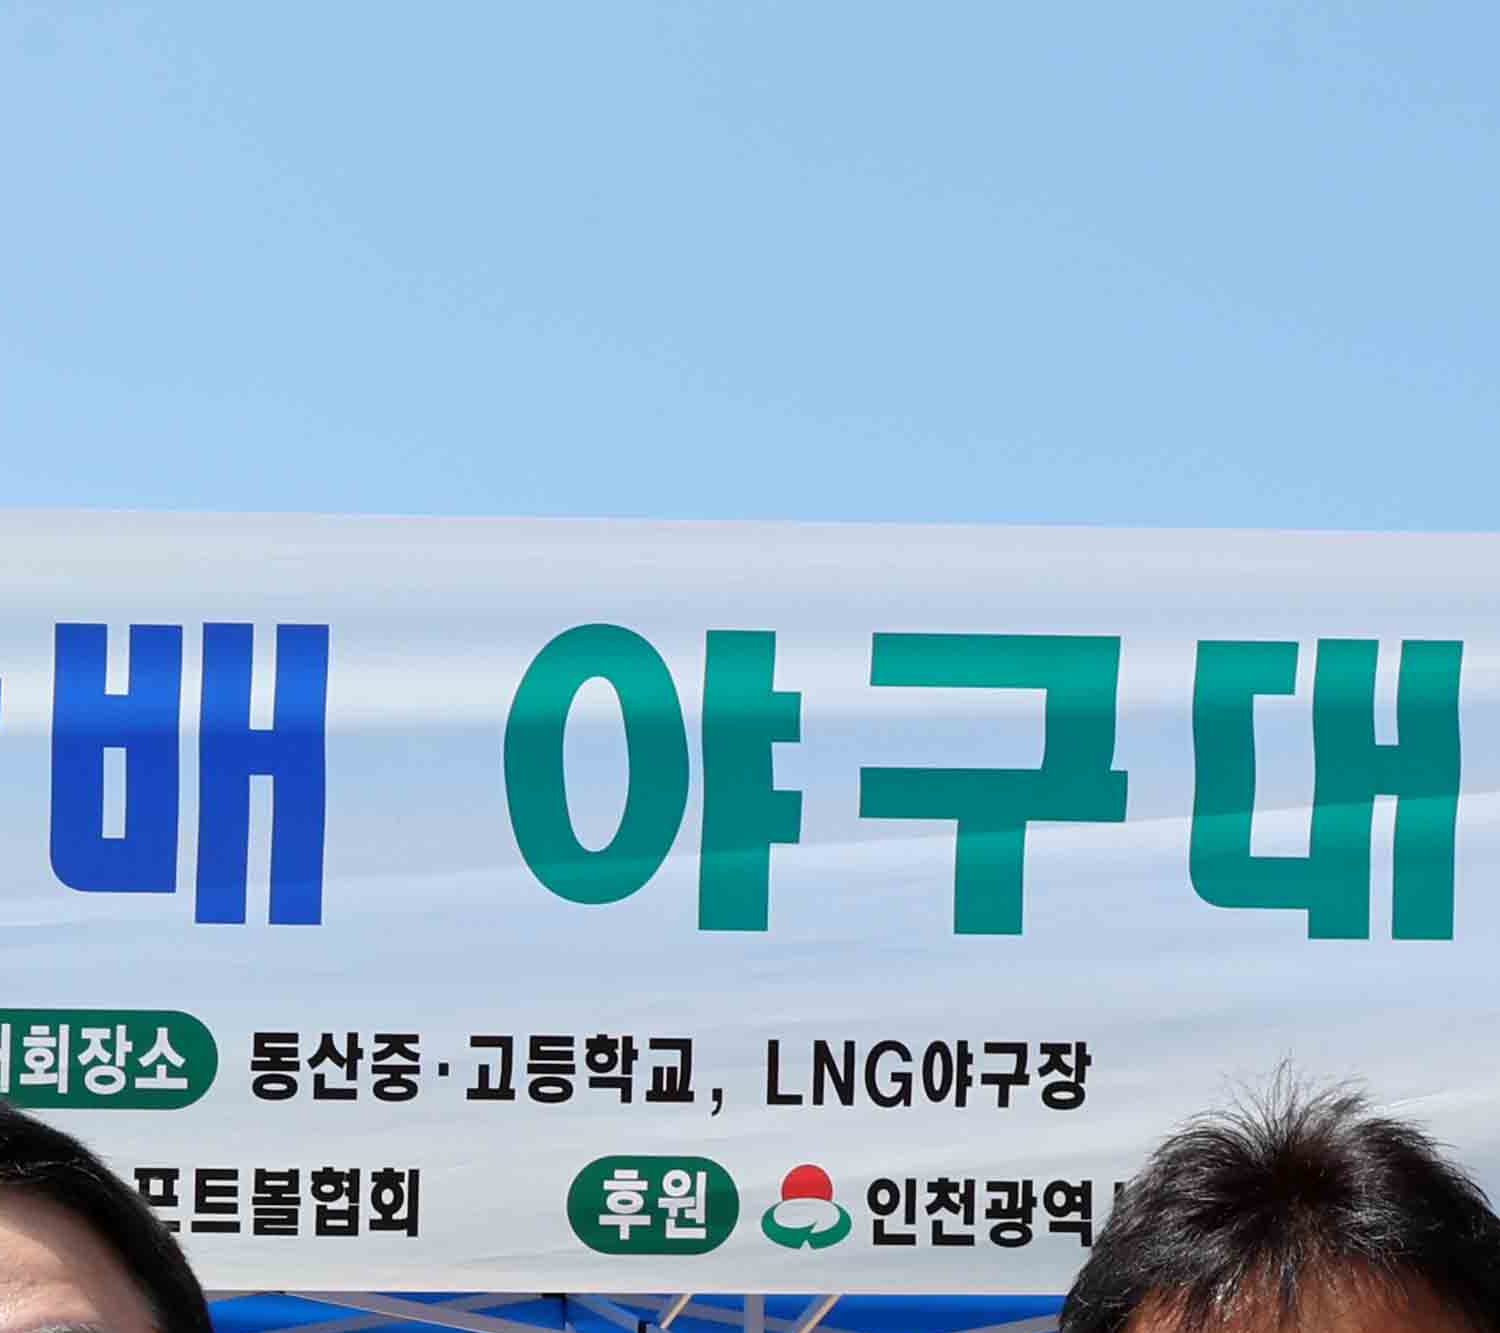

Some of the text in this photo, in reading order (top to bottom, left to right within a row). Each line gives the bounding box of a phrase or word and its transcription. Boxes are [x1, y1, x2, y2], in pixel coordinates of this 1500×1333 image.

[766, 1040, 1092, 1111] LNG야구장
[598, 1168, 1124, 1247] 후원 인천광역
